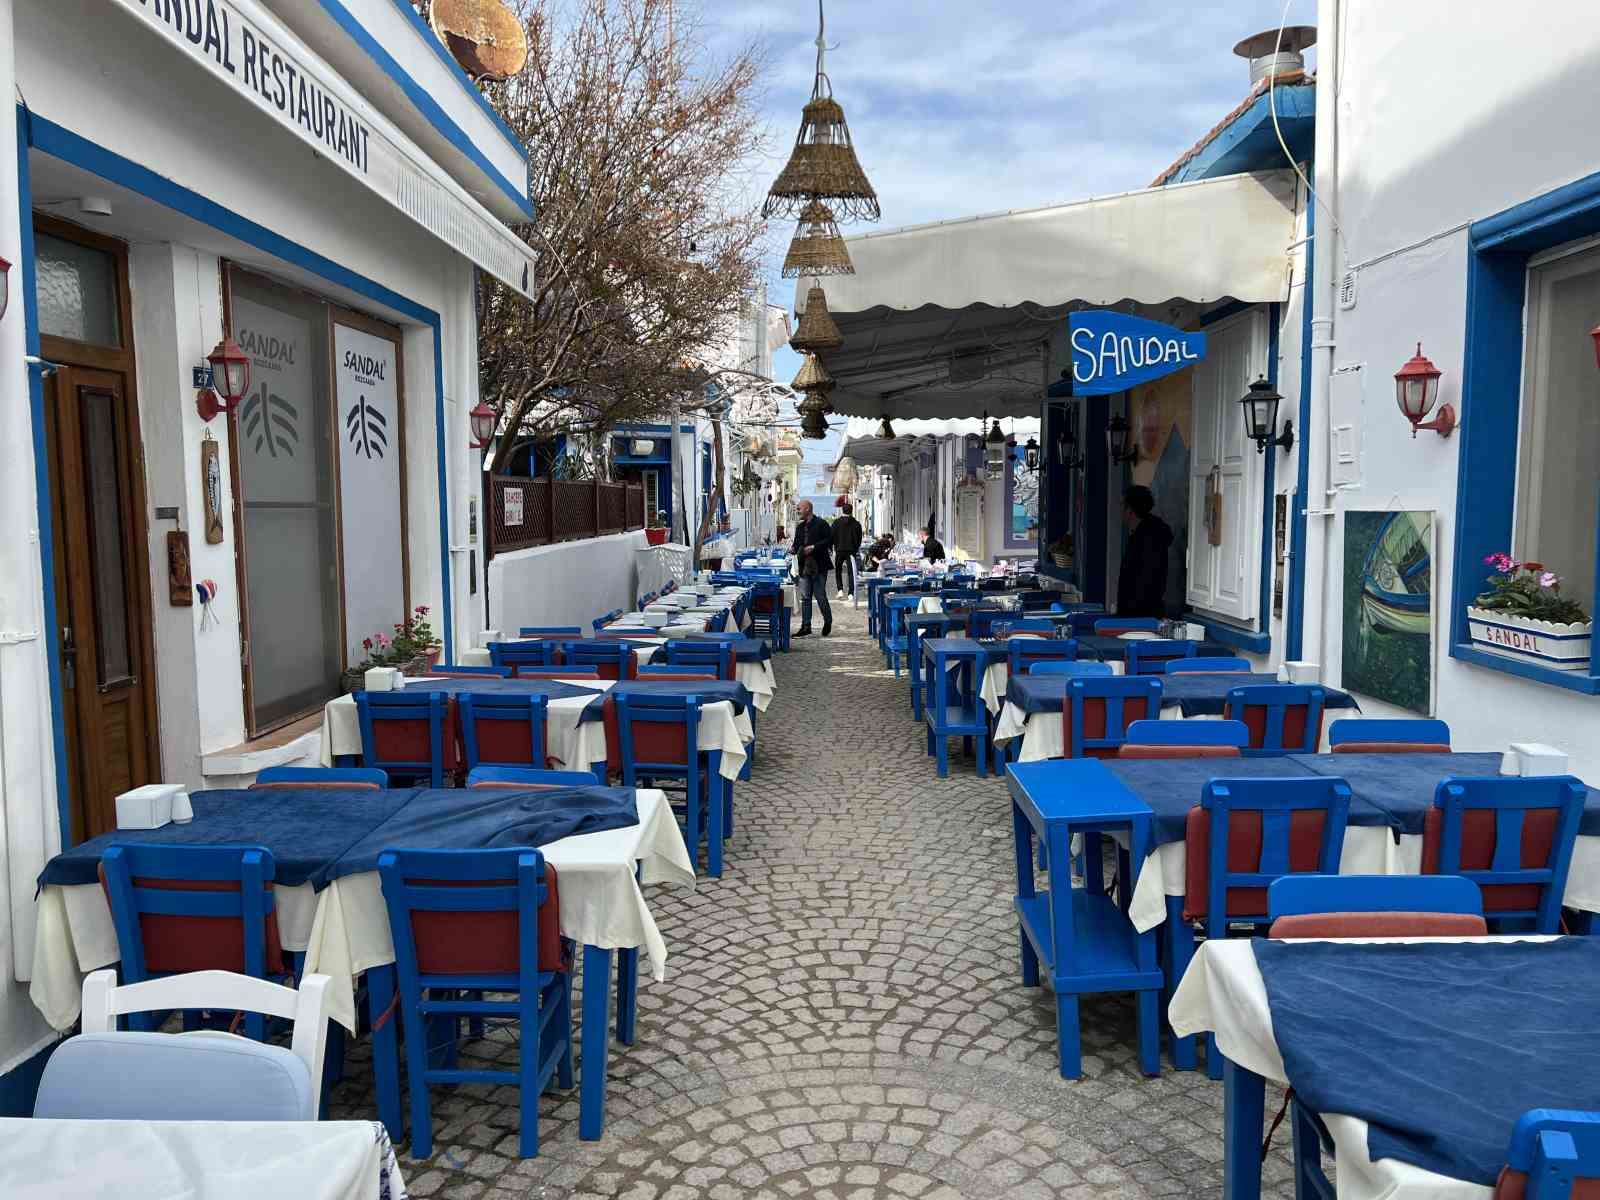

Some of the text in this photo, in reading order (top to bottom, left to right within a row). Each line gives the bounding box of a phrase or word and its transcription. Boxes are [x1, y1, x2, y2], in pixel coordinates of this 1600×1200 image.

[139, 0, 369, 173] DAL RESTAURANT
[239, 328, 295, 366] SANDAL
[343, 350, 385, 381] SANDAL
[1071, 327, 1198, 383] SANDAL
[1486, 626, 1541, 652] SANDAL
